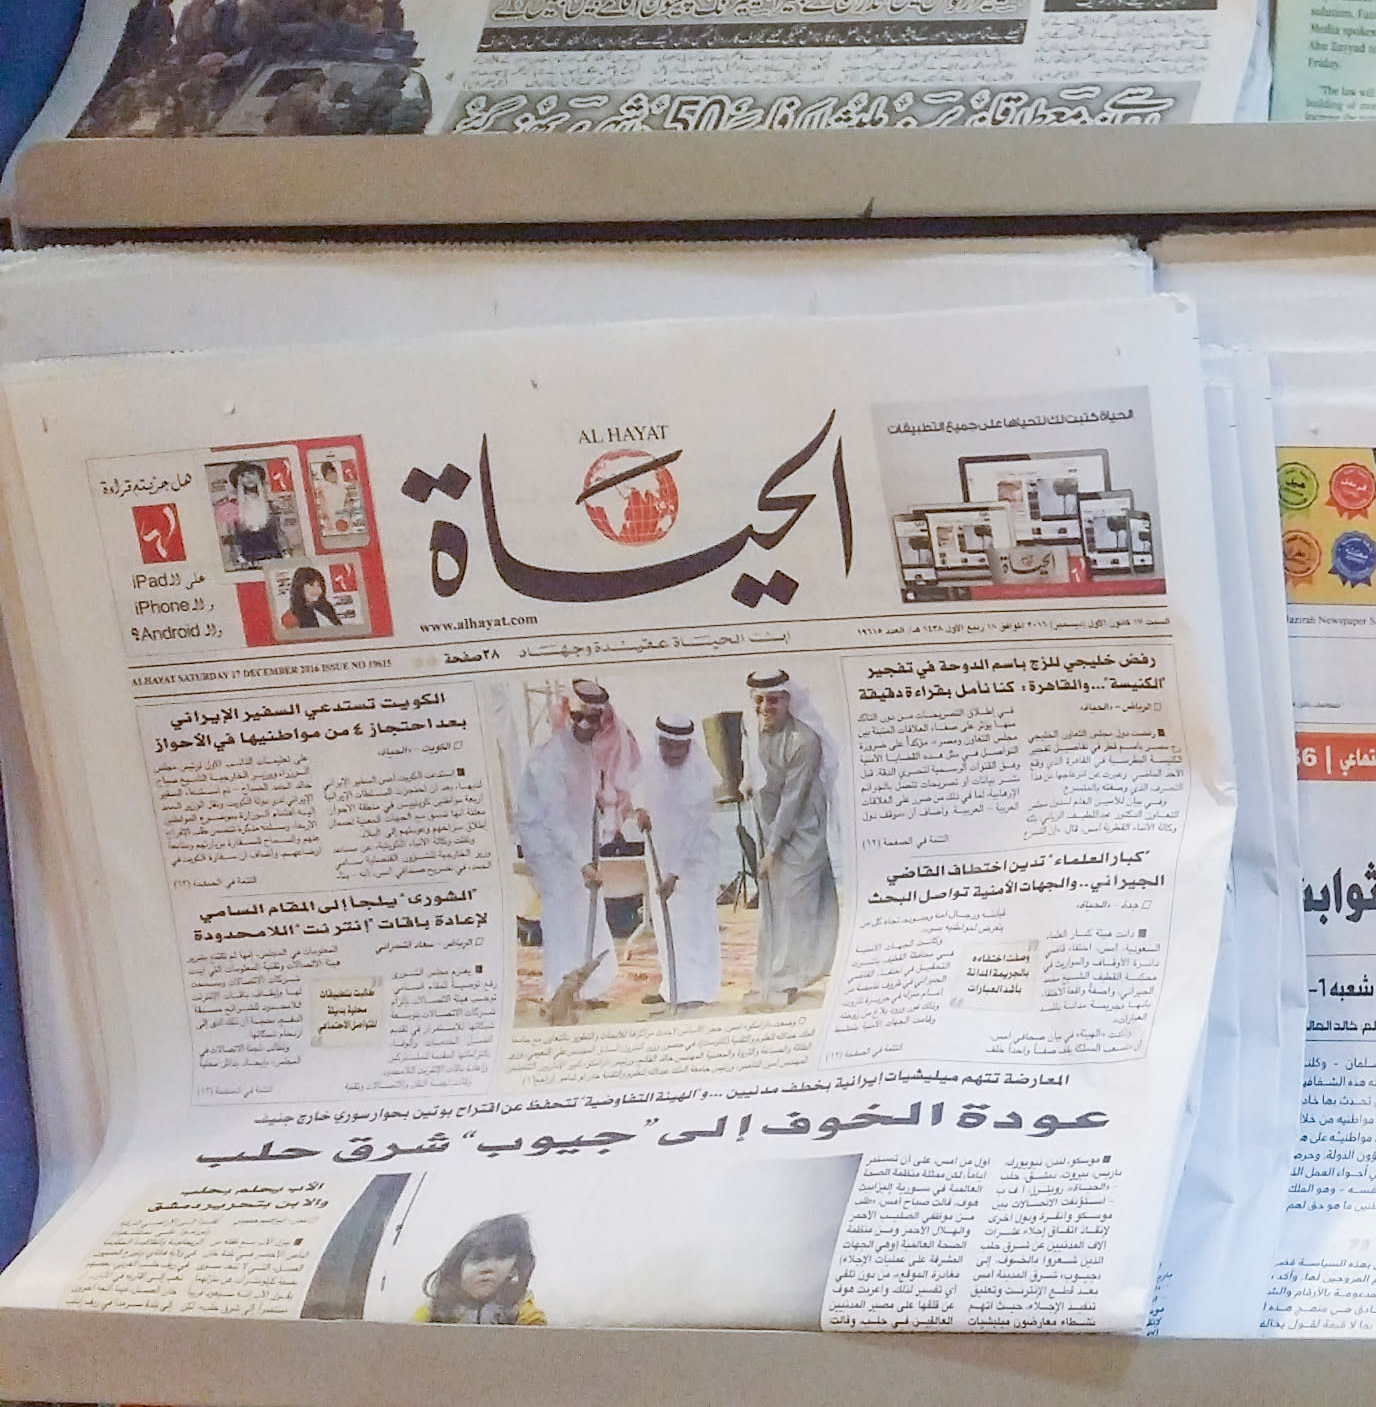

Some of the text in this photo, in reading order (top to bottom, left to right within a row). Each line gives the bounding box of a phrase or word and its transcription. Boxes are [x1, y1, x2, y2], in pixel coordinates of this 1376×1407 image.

[578, 423, 670, 445] AL HAYAT
[419, 613, 539, 634] www.alhayat.com
[243, 703, 301, 721] السفير
[305, 697, 376, 721] تستدعي
[380, 692, 445, 710] الكويت
[657, 1113, 752, 1149] إلى
[762, 1100, 944, 1142] الخوف
[957, 1099, 1110, 1138] عودة
[195, 1144, 322, 1171] حلب
[332, 1132, 452, 1165] شرق
